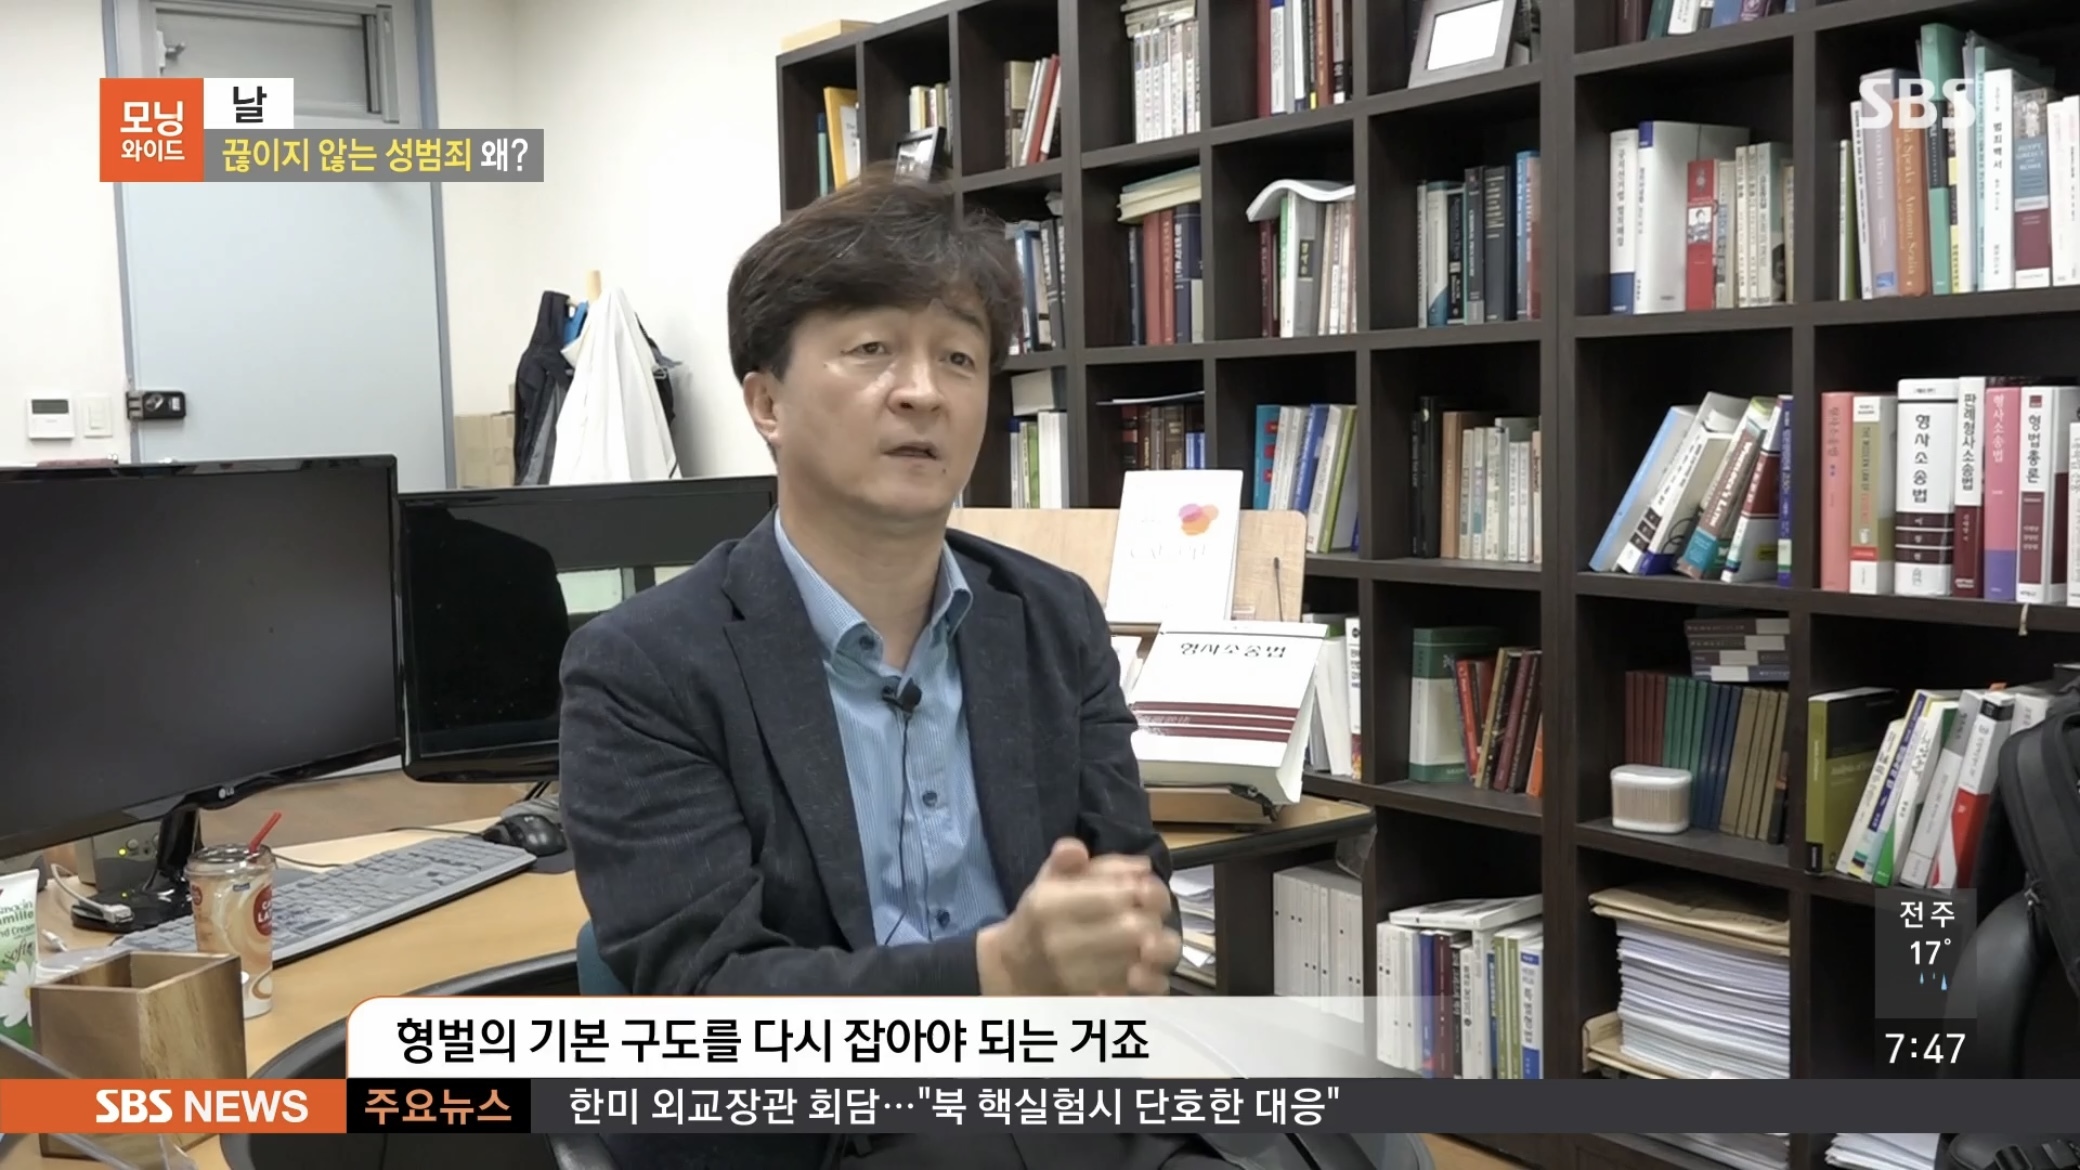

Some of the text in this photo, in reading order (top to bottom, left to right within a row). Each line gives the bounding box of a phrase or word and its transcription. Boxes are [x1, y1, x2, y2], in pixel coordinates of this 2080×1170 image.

[1912, 414, 1931, 504] 형사소송법
[1961, 393, 1977, 492] 판례형사소송법
[1992, 393, 2006, 464] 형사소송법
[2027, 414, 2043, 484] 형법총론
[1180, 642, 1287, 658] 형사소송법
